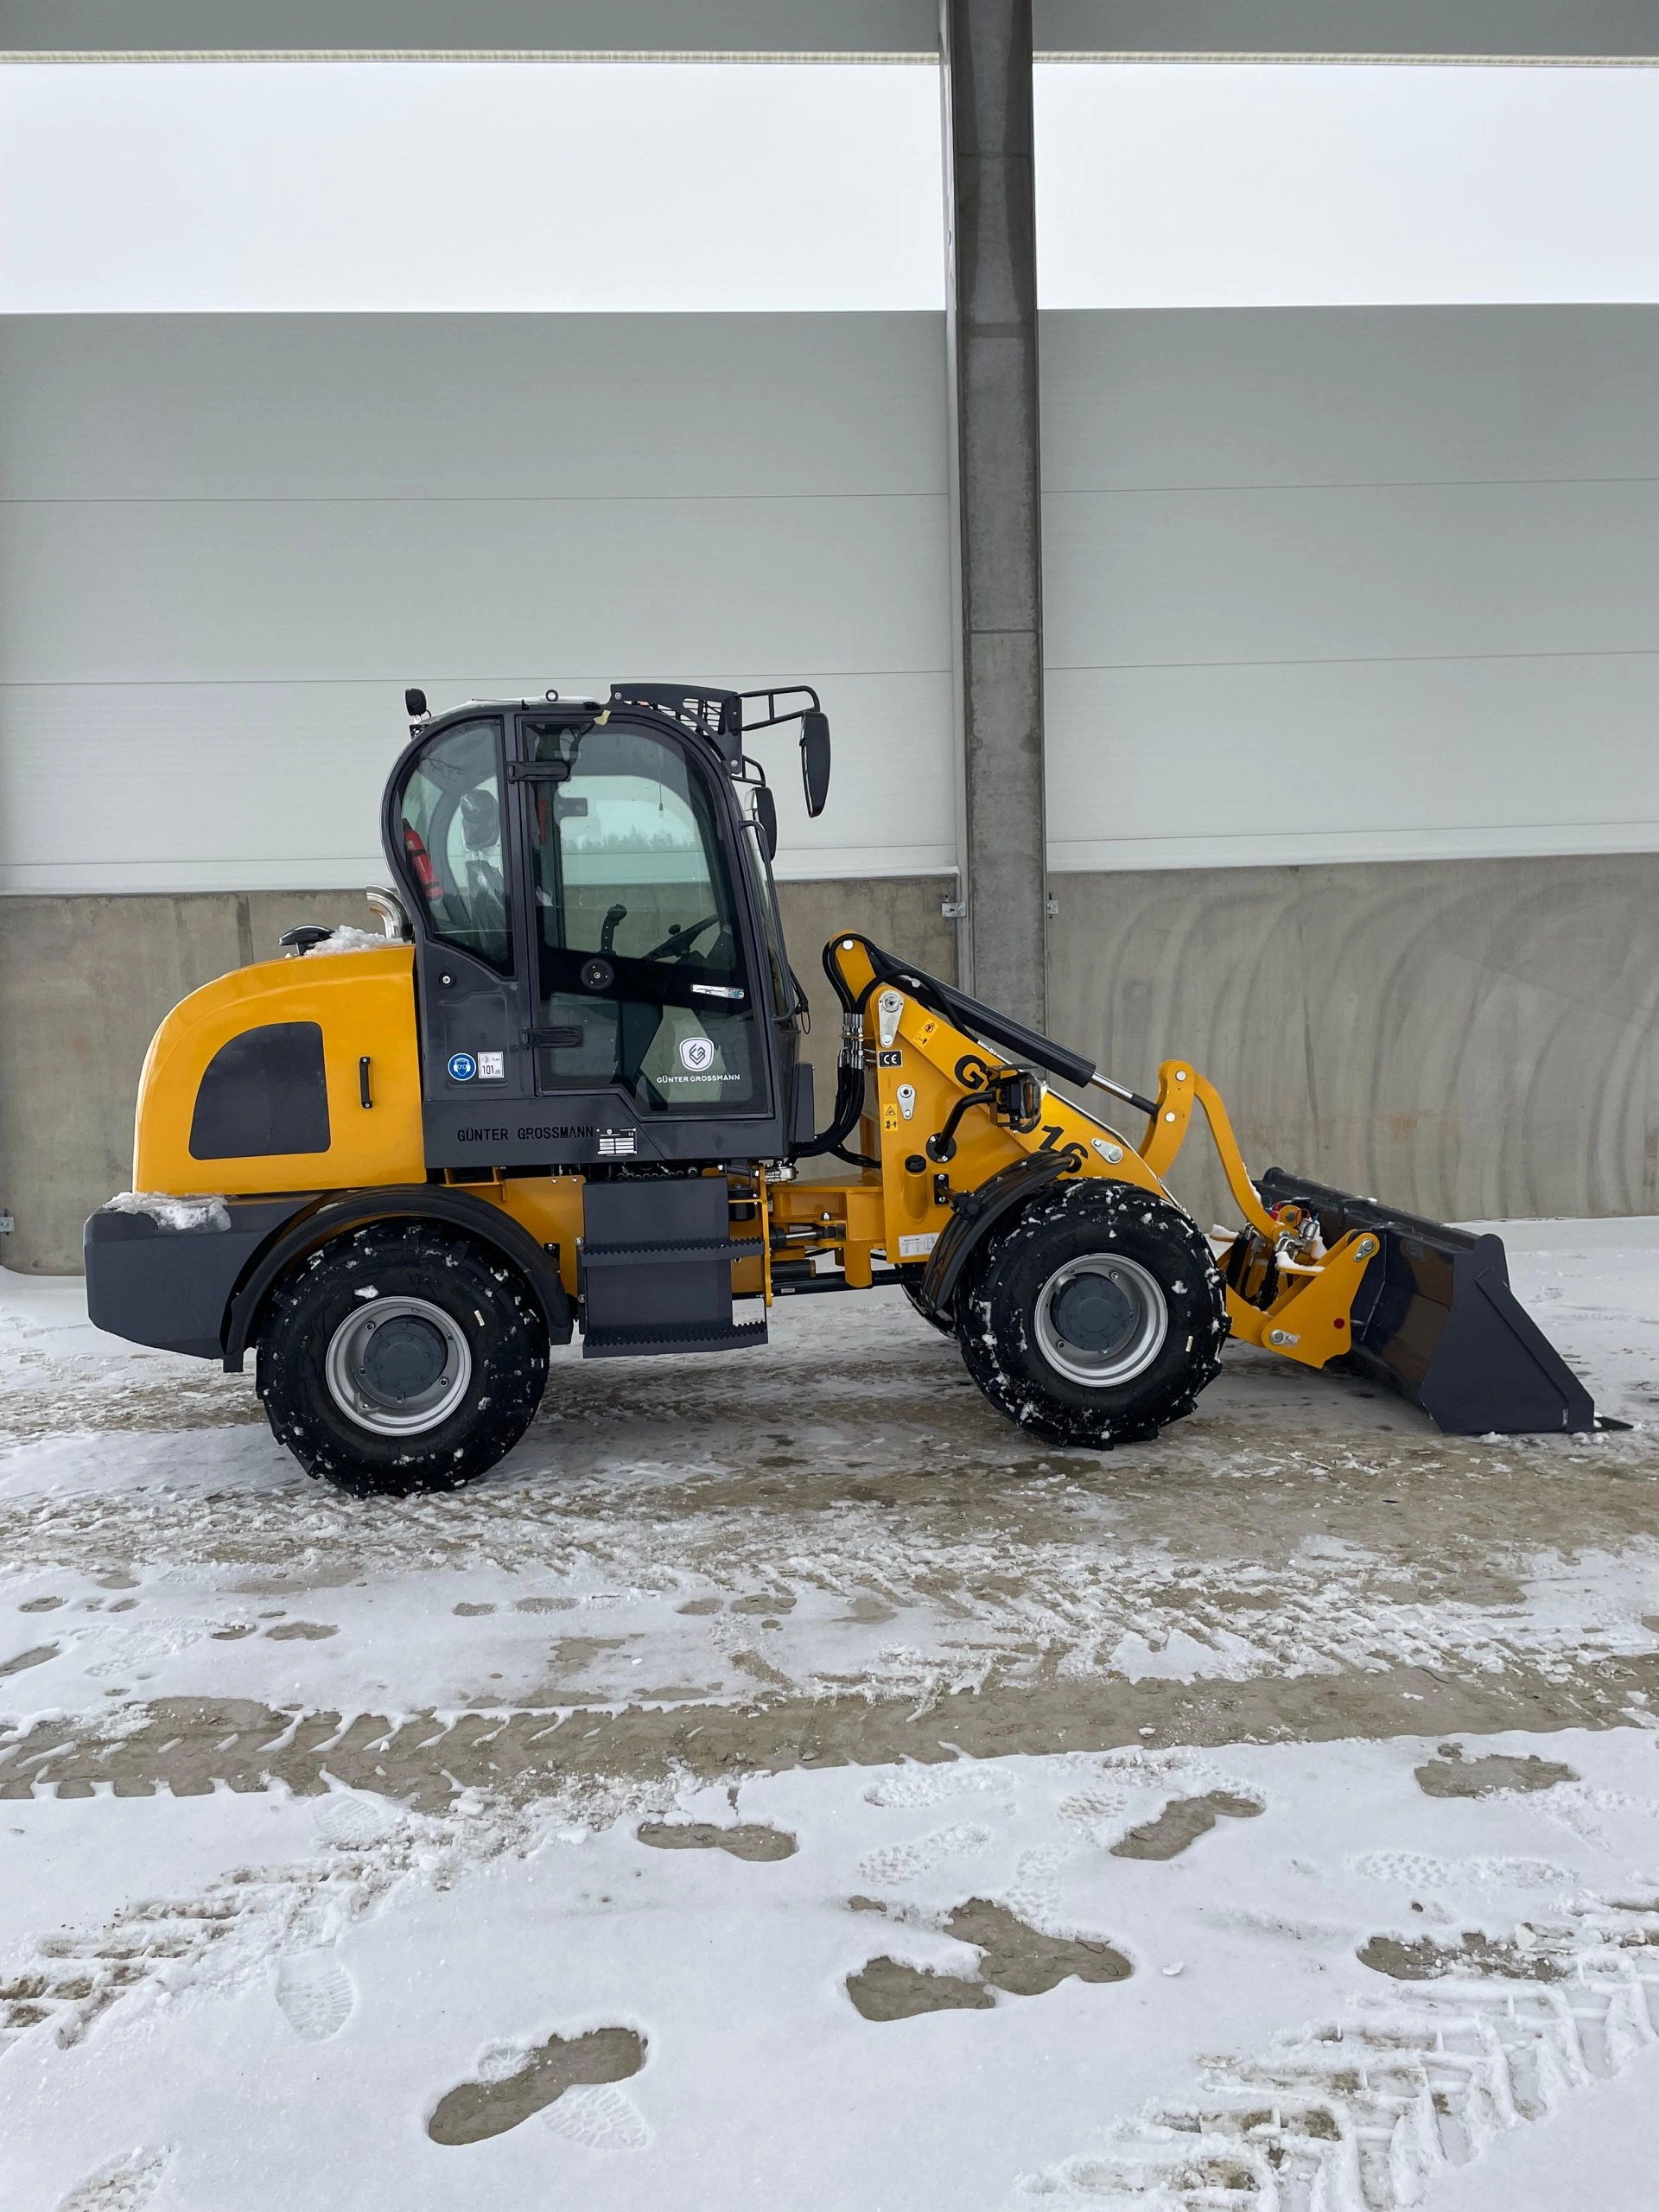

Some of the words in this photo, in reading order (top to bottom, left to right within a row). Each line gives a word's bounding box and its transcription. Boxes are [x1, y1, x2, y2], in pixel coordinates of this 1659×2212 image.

[883, 1054, 898, 1065] CE
[482, 1065, 494, 1075] 101
[657, 1075, 690, 1084] GÜNTER
[954, 1054, 1089, 1173] G16
[457, 1127, 509, 1141] GÜNTER
[518, 1126, 594, 1140] GROSSMANN
